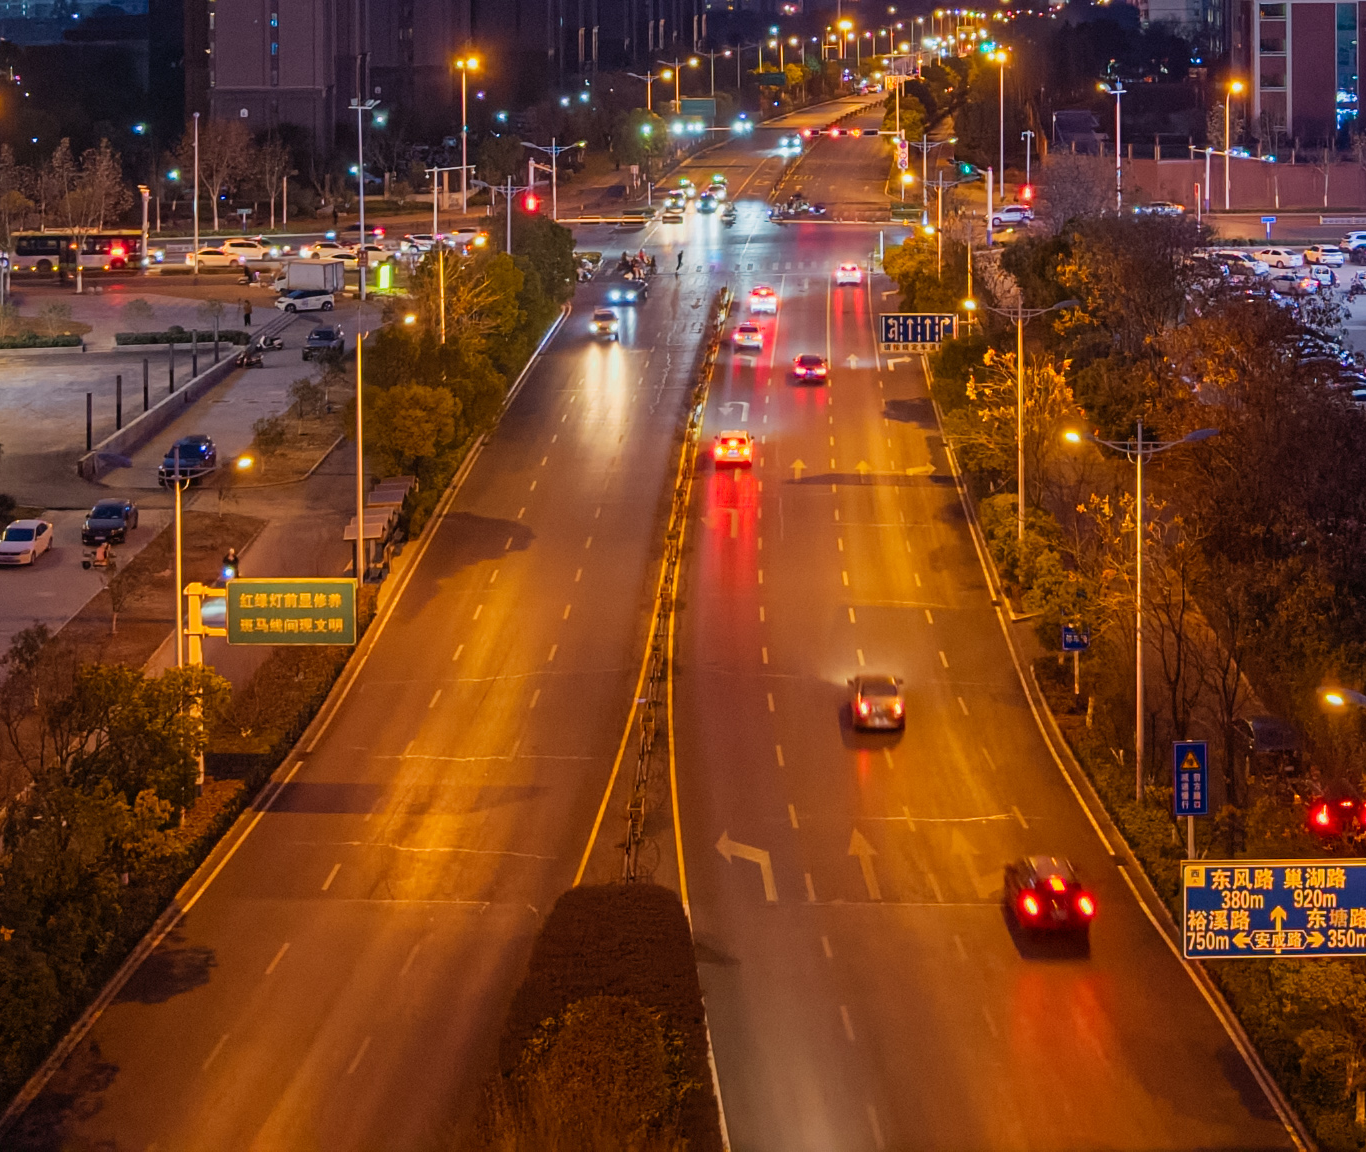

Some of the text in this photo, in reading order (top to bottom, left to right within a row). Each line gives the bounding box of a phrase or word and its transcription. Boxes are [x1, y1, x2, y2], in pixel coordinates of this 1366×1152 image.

[239, 593, 341, 608] 红绿灯前显修养
[239, 619, 343, 633] 斑马线间现文明
[1211, 868, 1347, 890] 东风路 巢湖路
[1221, 890, 1337, 909] 380m 920m
[1187, 910, 1251, 931] 裕溪路
[1187, 932, 1230, 950] 750m
[1254, 932, 1302, 948] 安成路
